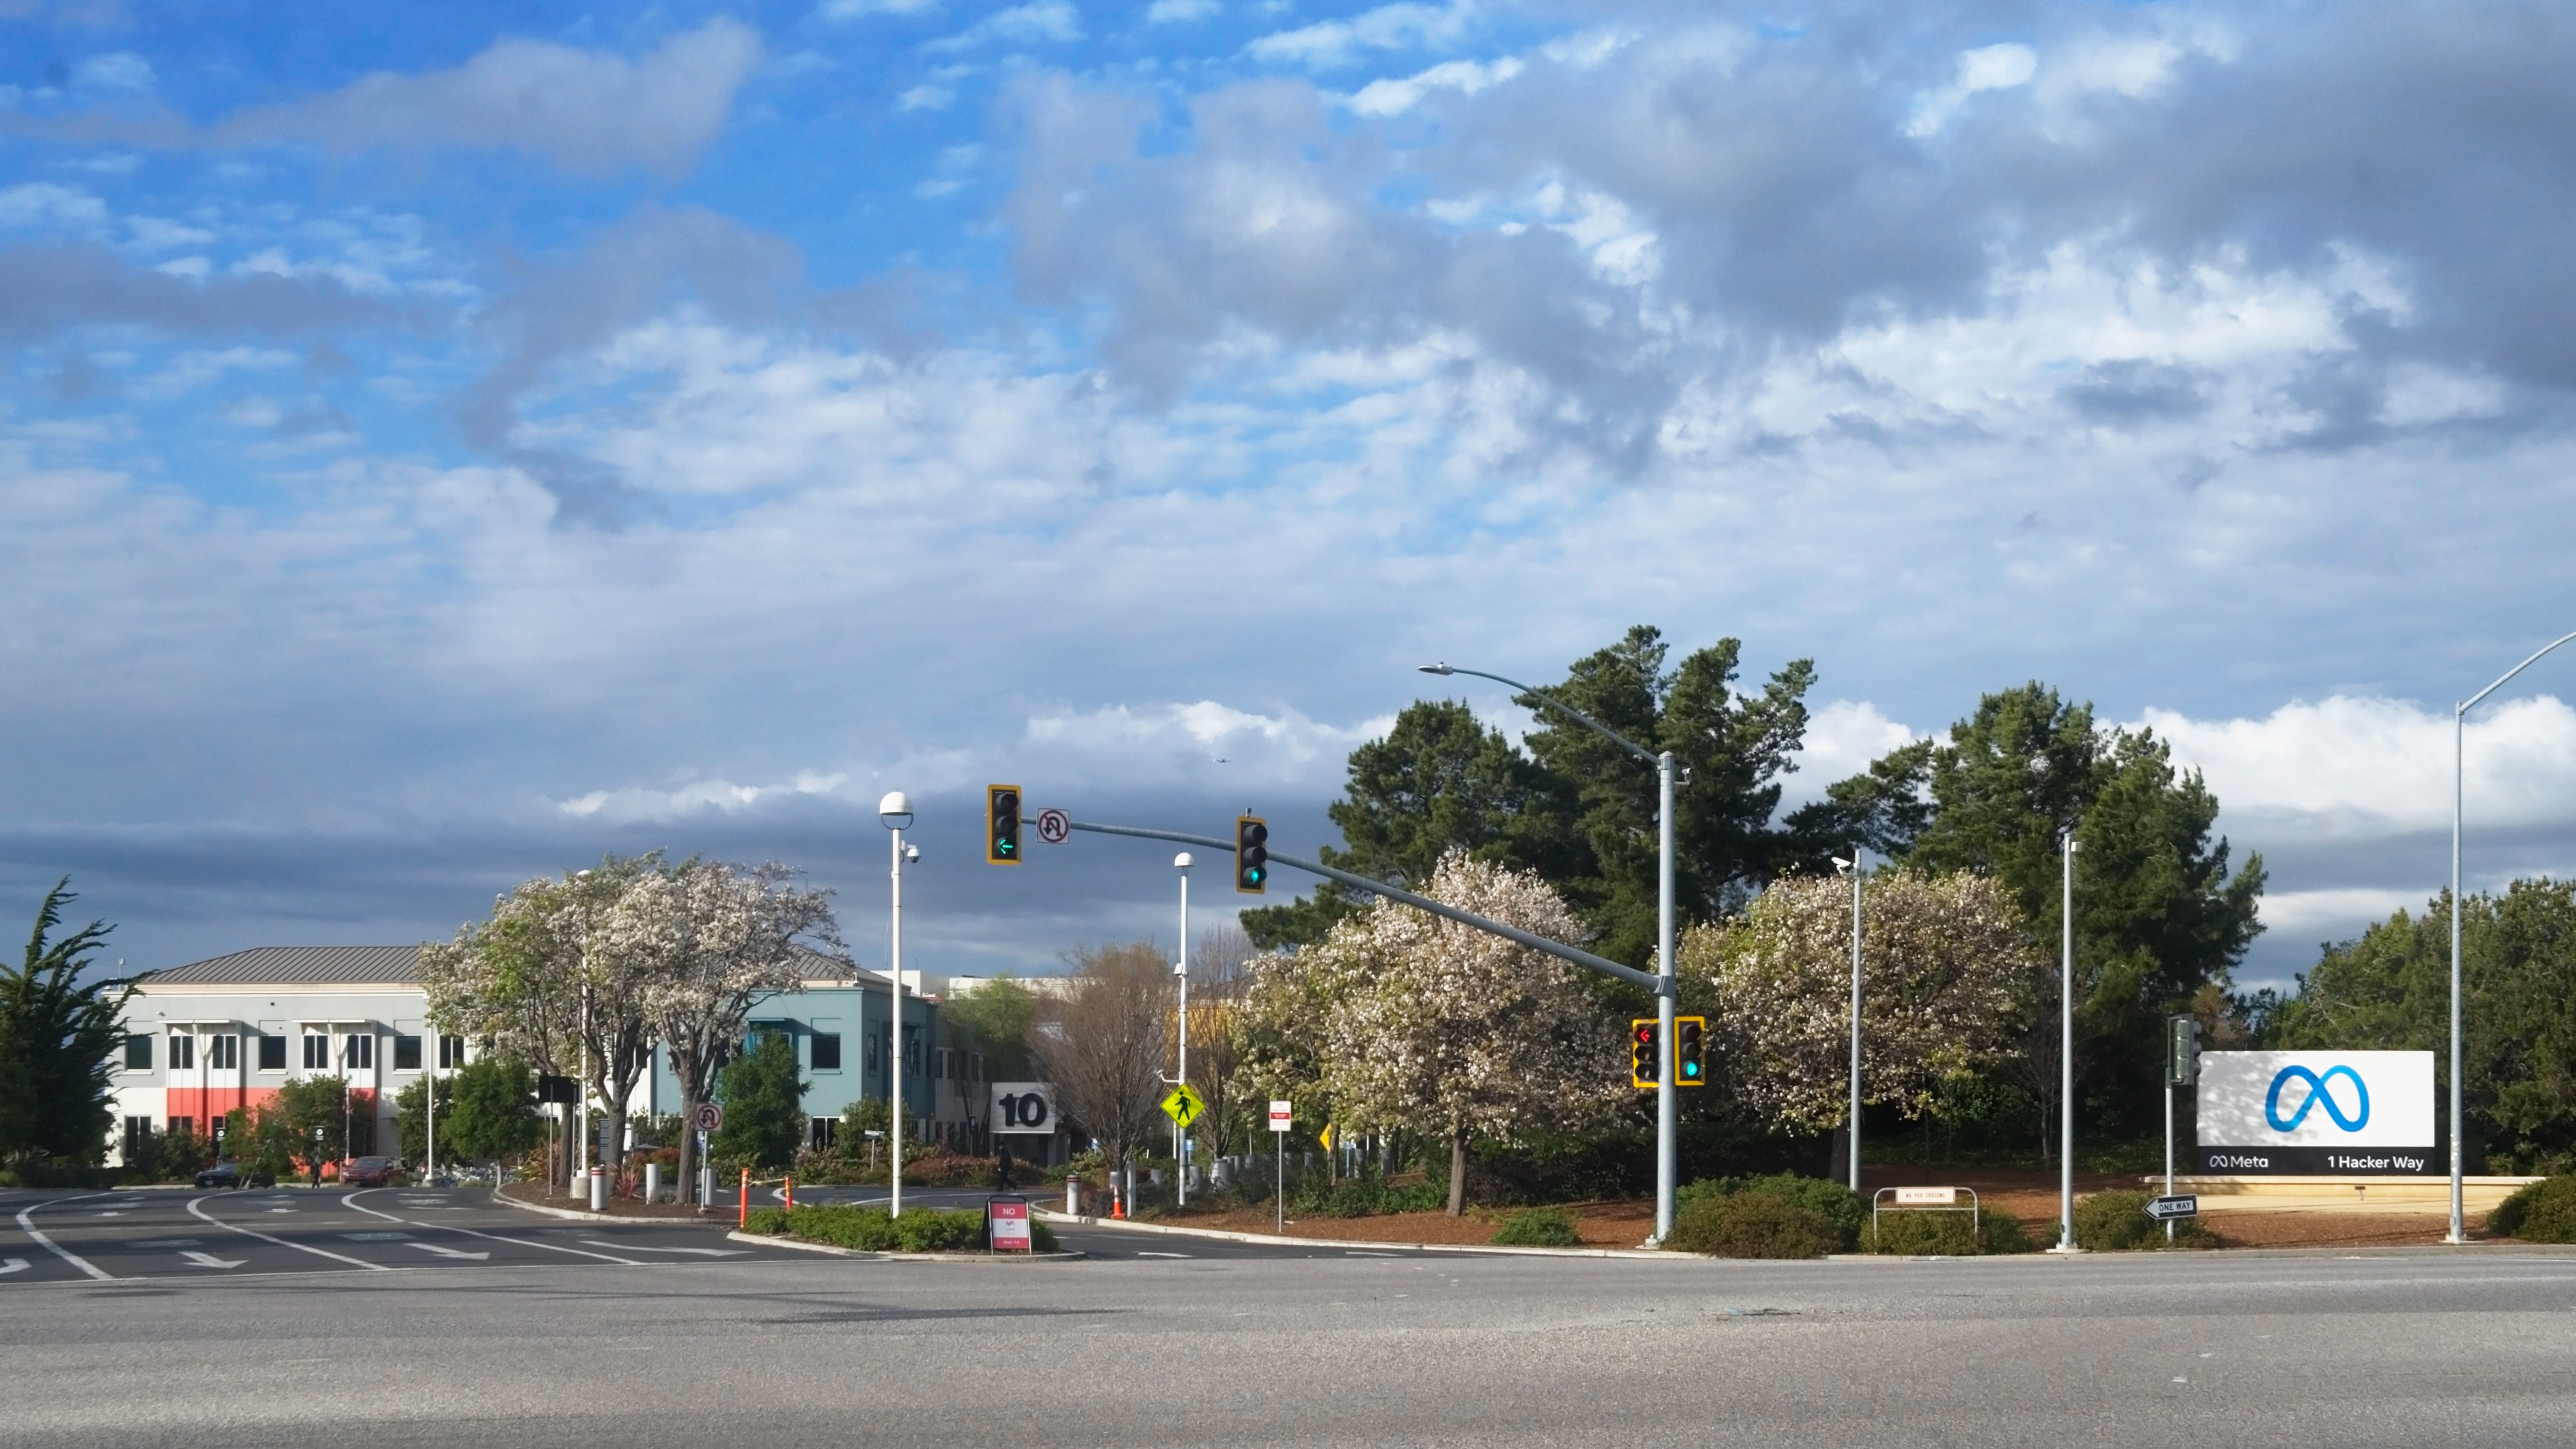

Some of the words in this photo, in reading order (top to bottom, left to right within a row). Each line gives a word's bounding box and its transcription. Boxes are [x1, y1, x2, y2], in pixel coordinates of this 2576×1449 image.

[999, 1093, 1048, 1127] 10
[2230, 1156, 2269, 1168] Meta
[2328, 1156, 2334, 1168] 1
[2338, 1156, 2390, 1168] Hacker
[2392, 1156, 2424, 1172] Way
[2159, 1203, 2174, 1211] ONE
[2176, 1202, 2191, 1210] WAY
